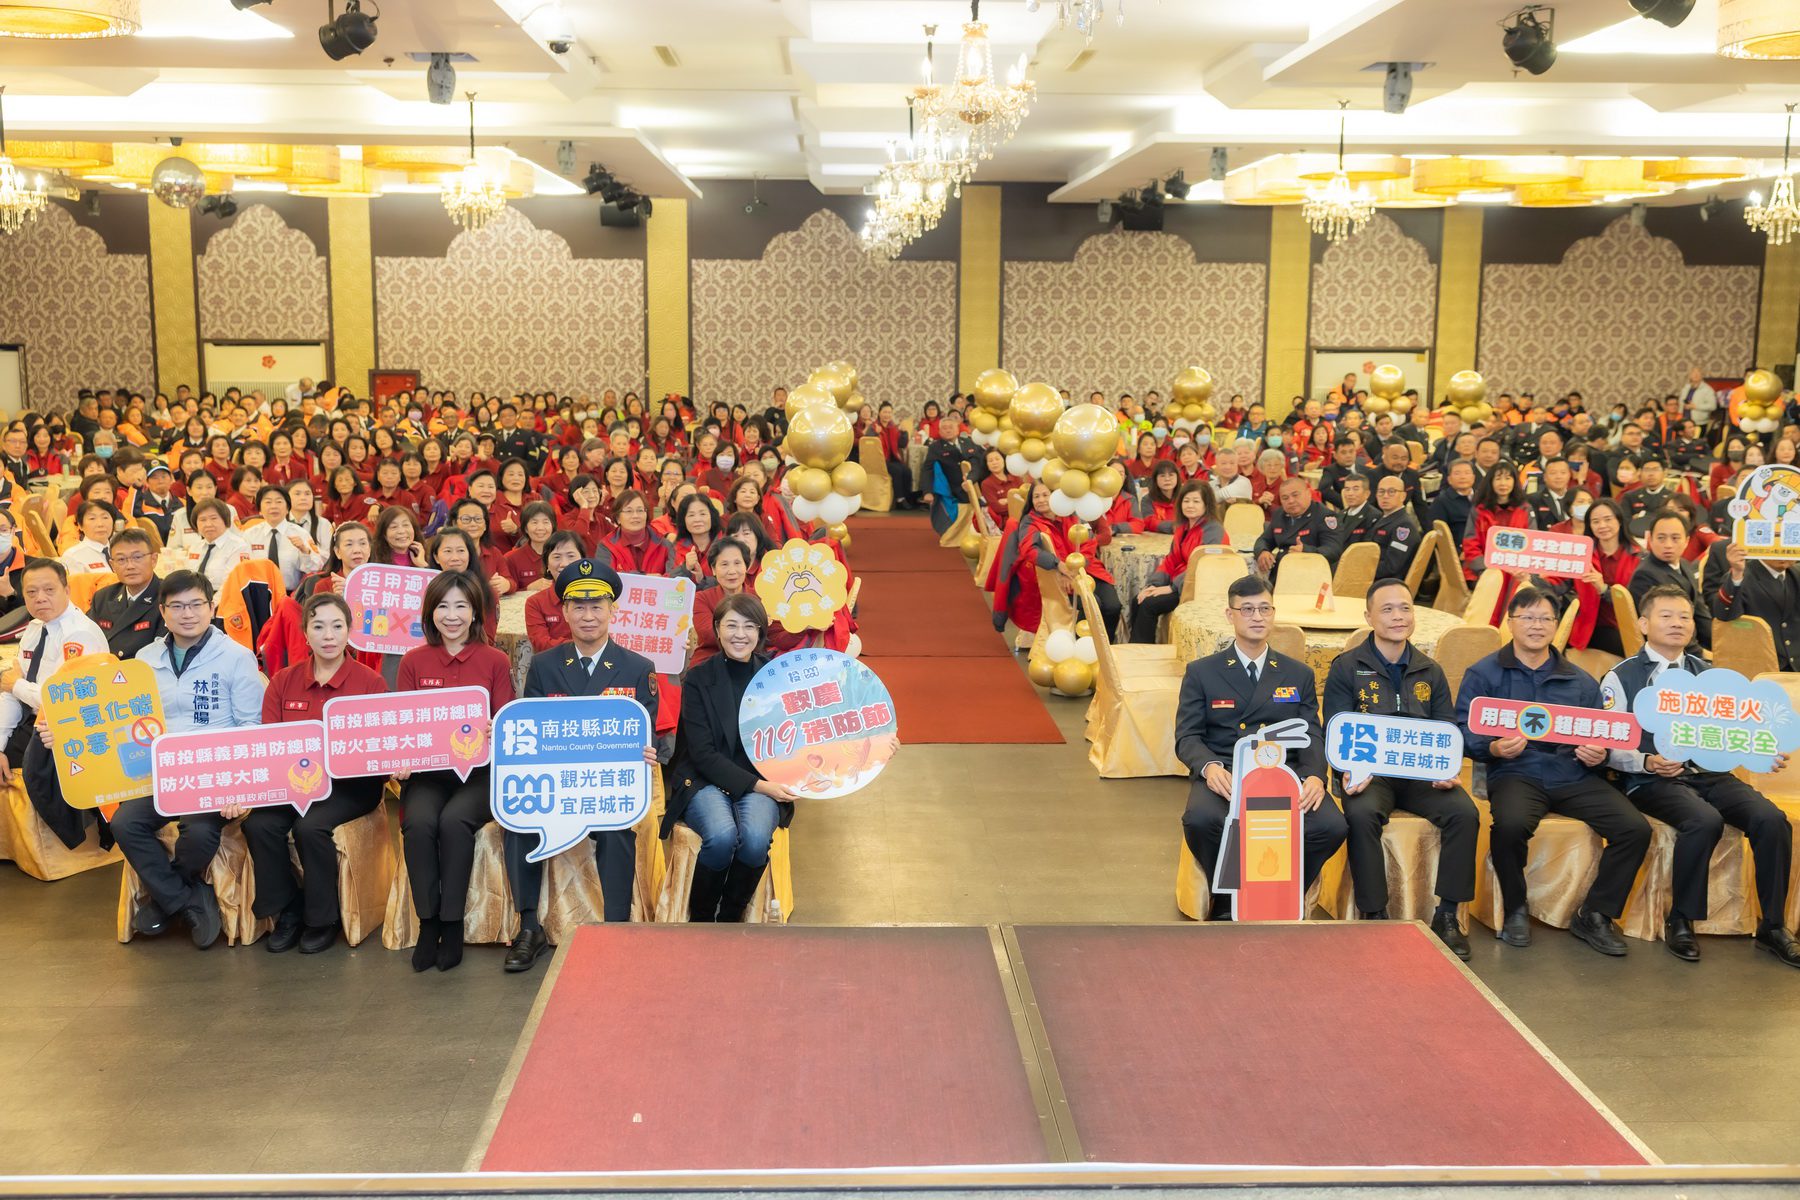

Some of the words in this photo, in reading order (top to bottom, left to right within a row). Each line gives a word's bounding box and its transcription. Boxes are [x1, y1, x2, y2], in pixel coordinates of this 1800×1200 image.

[1496, 532, 1526, 549] 沒有
[361, 570, 434, 592] 拒用逾
[628, 587, 658, 606] 用電
[609, 632, 674, 655] 險遠離我
[47, 676, 98, 704] 防範
[780, 681, 844, 717] 歡慶
[57, 693, 154, 728] 一氧化碳
[329, 703, 484, 731] 南投縣義勇消防總隊
[1657, 690, 1763, 722] 施放煙火
[502, 719, 538, 756] 投
[541, 718, 641, 739] 南投縣政府
[752, 719, 797, 761] 119
[801, 702, 893, 746] 消防節
[1480, 706, 1518, 730] 用電
[1524, 712, 1546, 734] 不
[1553, 715, 1631, 742] 超過負載
[63, 731, 110, 760] 中毒
[331, 733, 433, 756] 防火宣導大隊
[541, 744, 567, 752] Nantou
[569, 742, 595, 752] County
[597, 742, 640, 750] Government
[1338, 721, 1379, 764] 投
[1385, 727, 1452, 749] 觀光首都
[1670, 722, 1777, 755] 注意安全
[128, 750, 146, 760] GAS
[158, 737, 322, 768] 南投縣義勇消防總隊
[381, 756, 430, 769] 南投縣政府
[1384, 750, 1450, 771] 宜居城市
[160, 767, 270, 793] 防火宣導大隊
[560, 768, 636, 788] 觀光首都
[215, 791, 268, 805] 南投縣政府
[560, 795, 636, 816] 宜居城市
